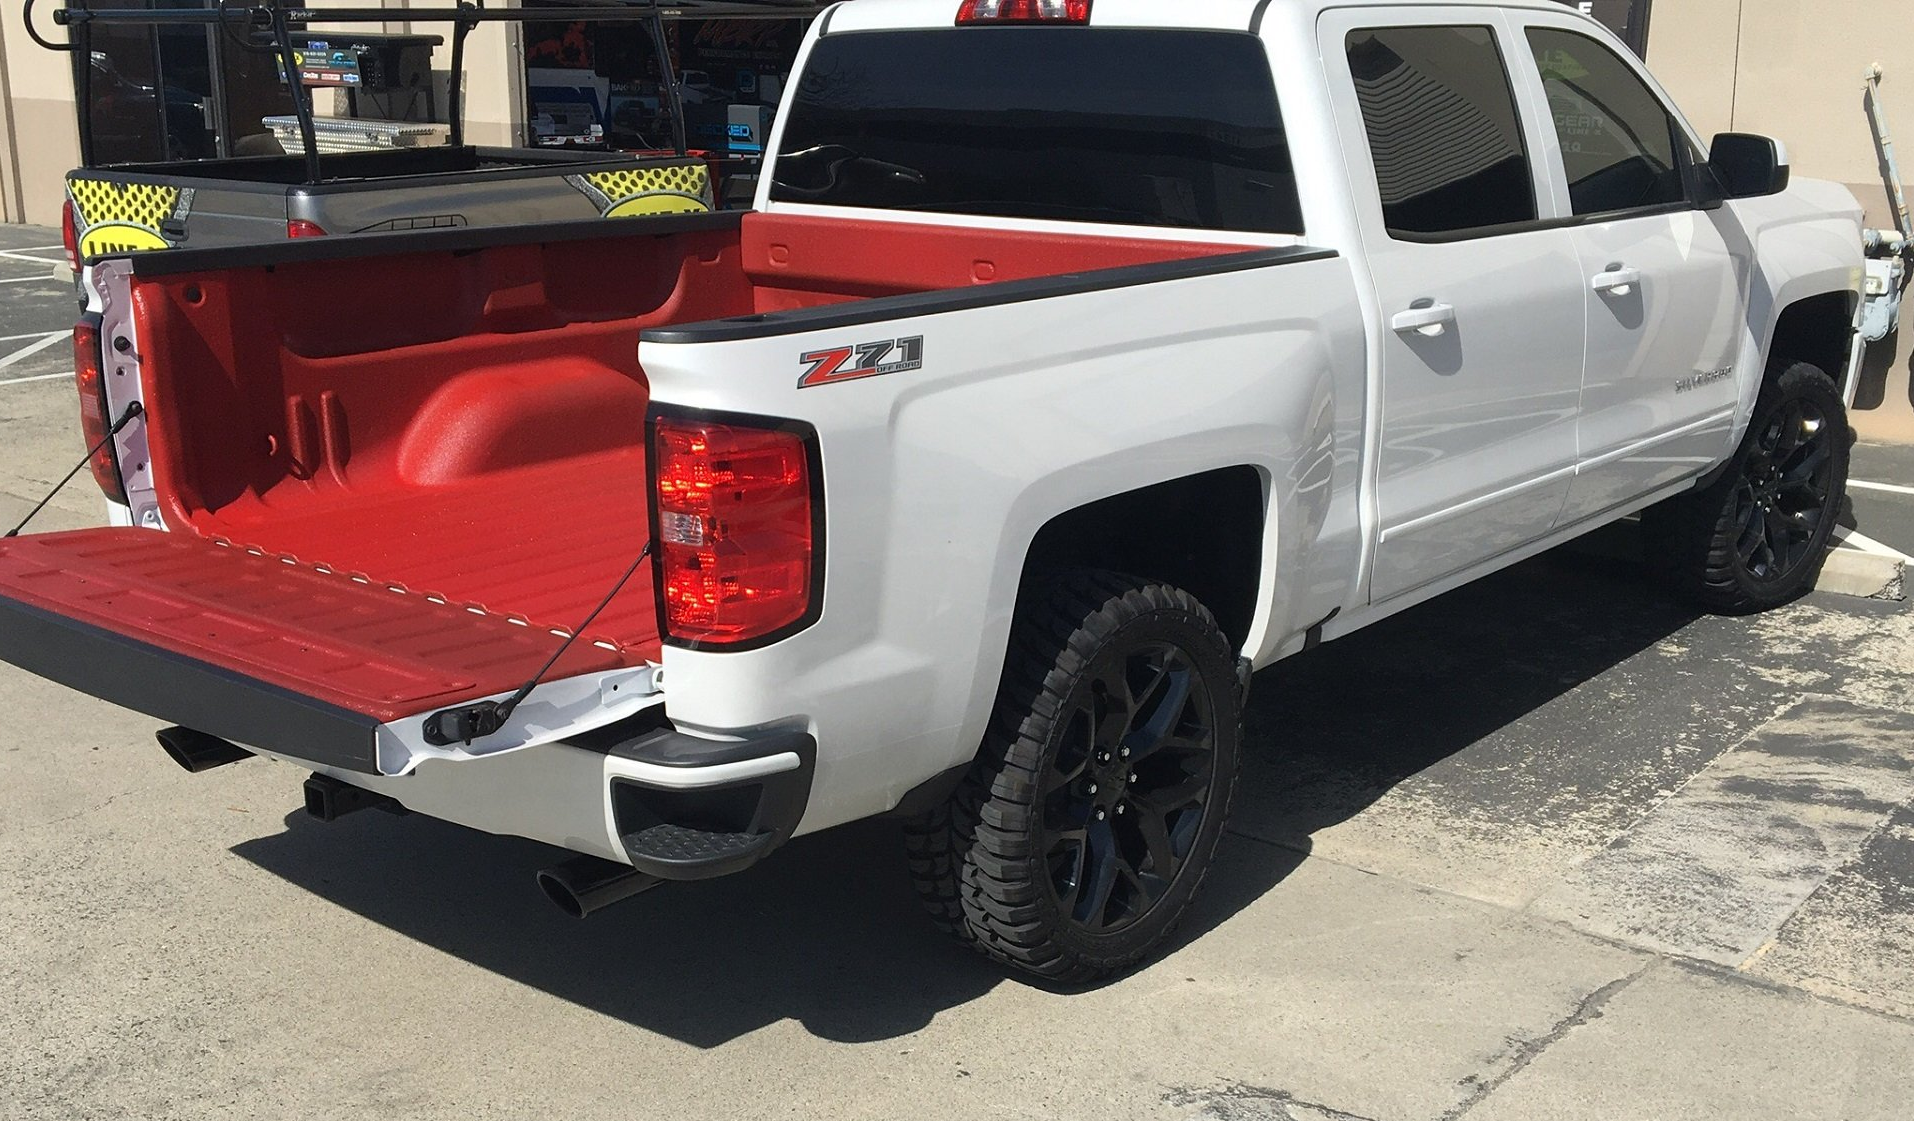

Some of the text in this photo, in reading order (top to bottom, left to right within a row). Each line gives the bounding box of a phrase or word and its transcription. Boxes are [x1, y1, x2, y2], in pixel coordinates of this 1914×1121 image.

[797, 335, 923, 389] Z71
[876, 361, 920, 373] OFF ROAD
